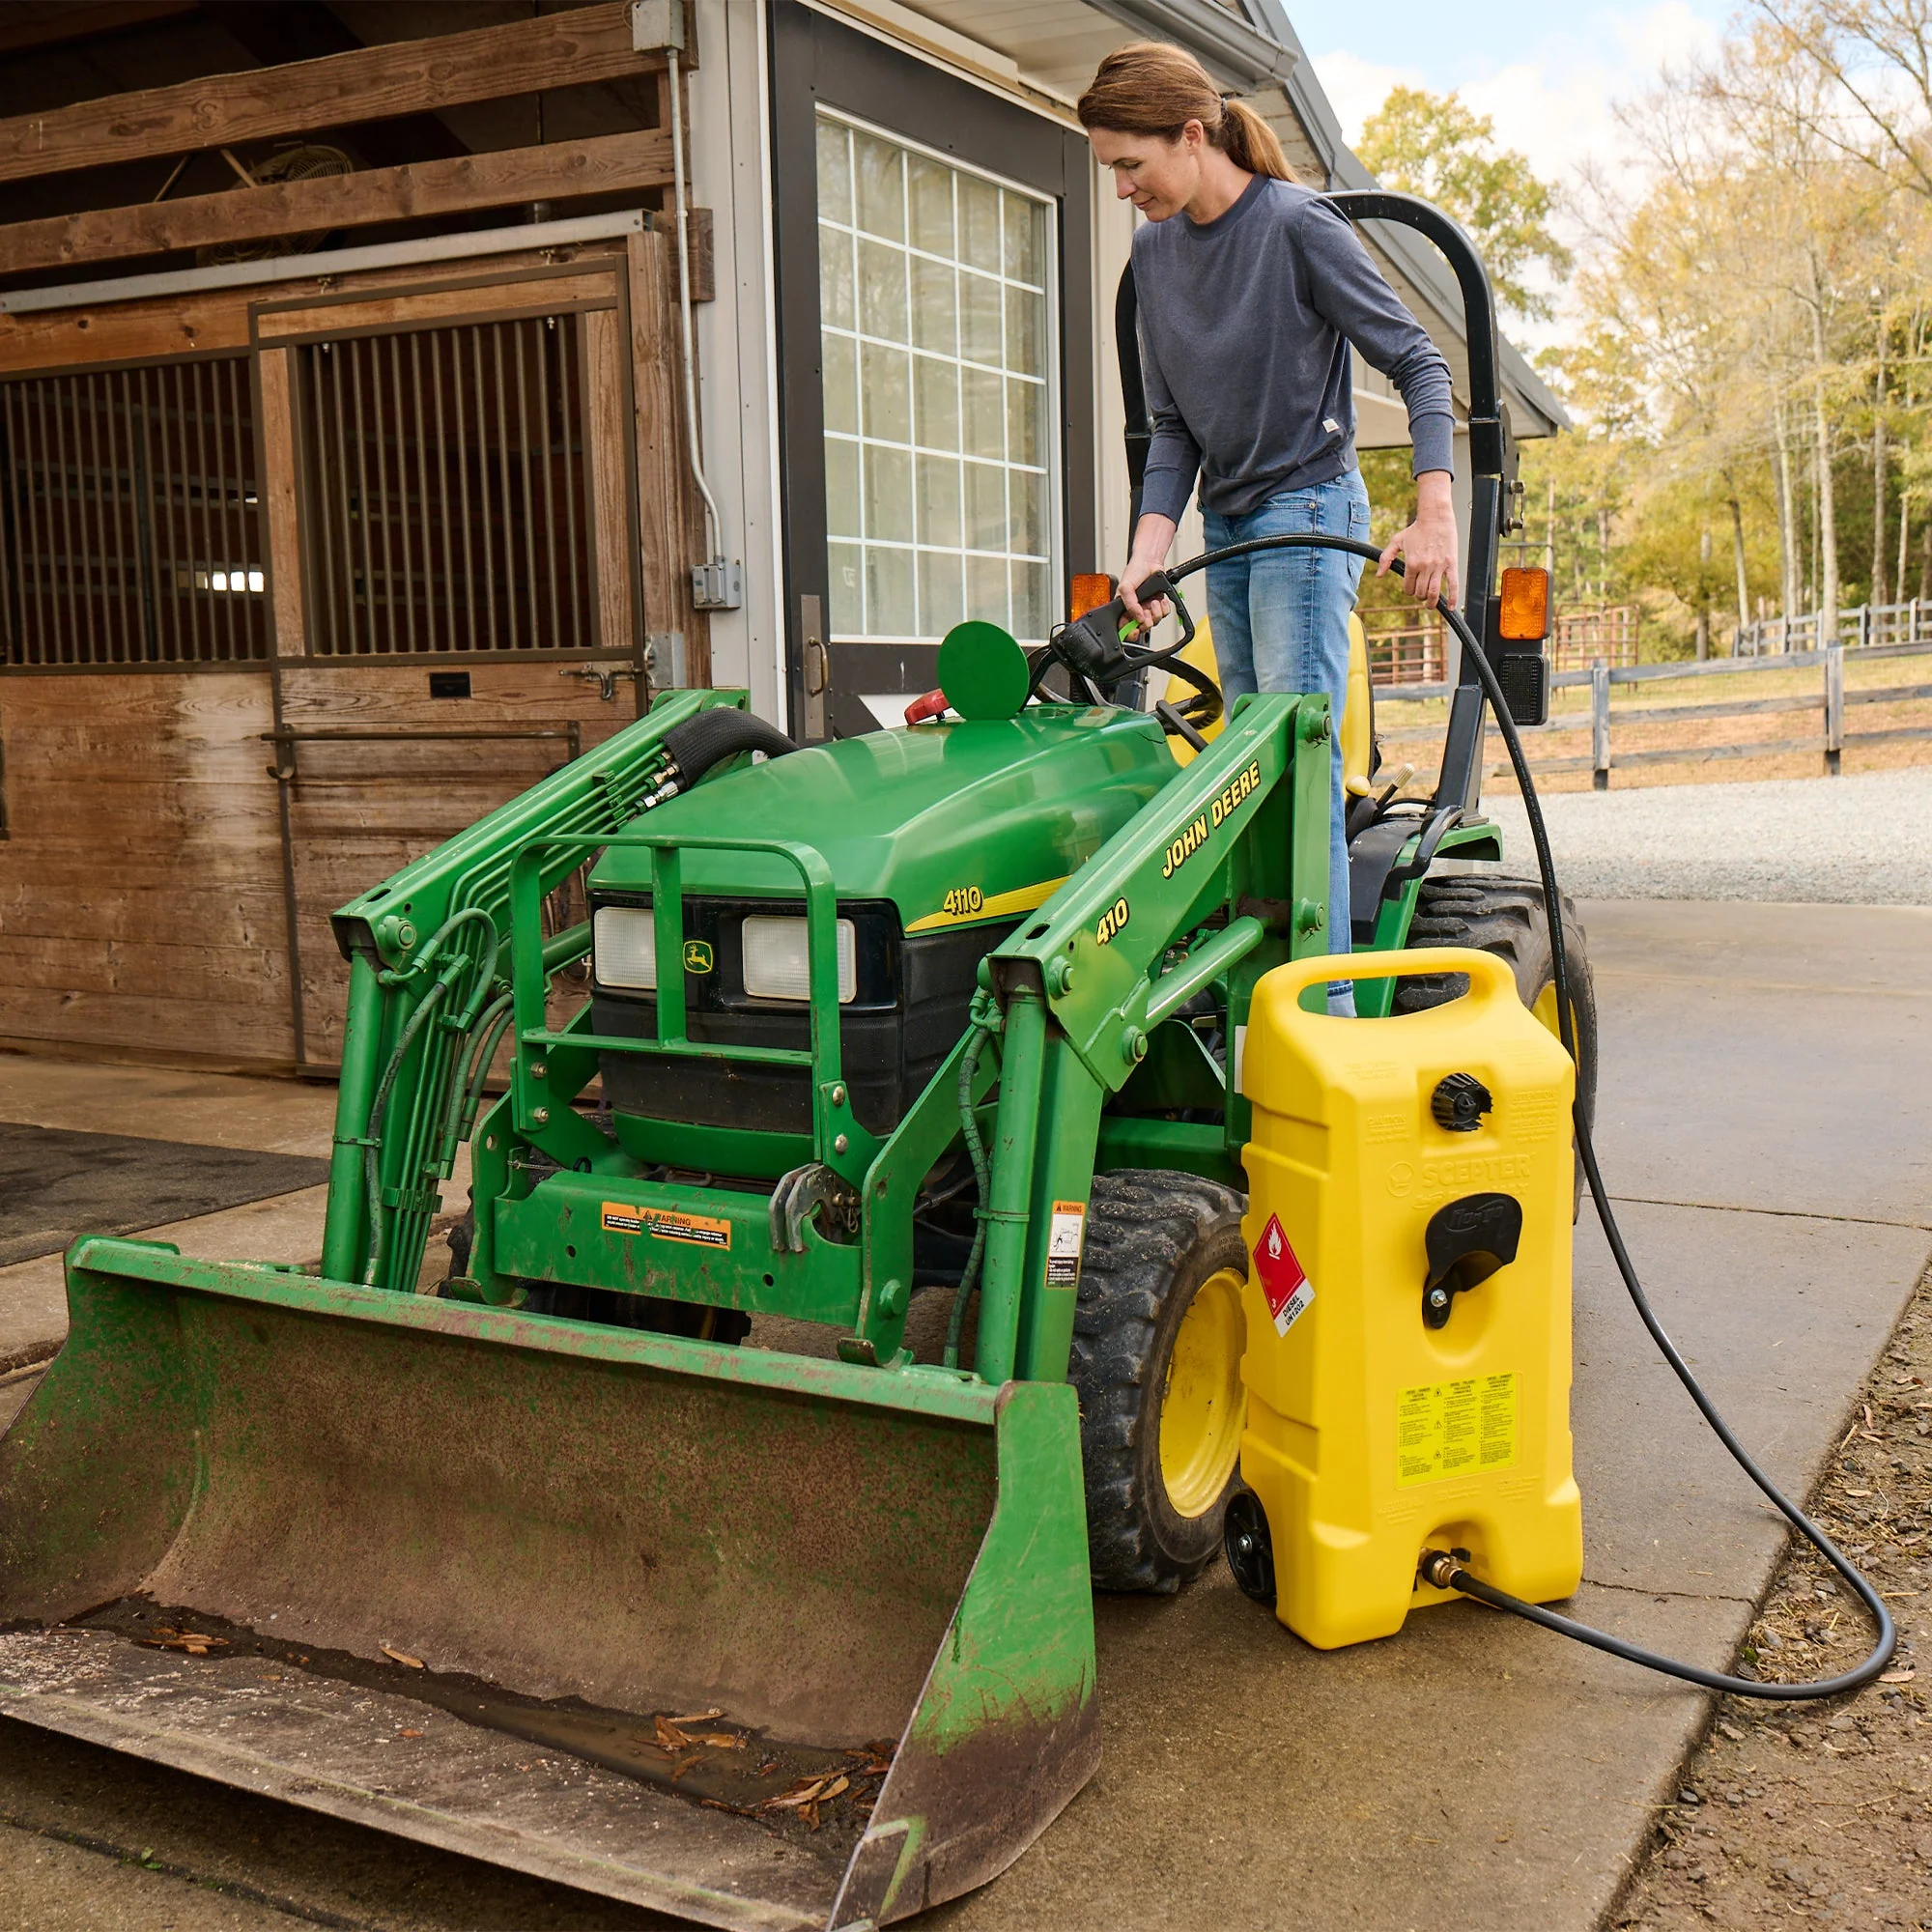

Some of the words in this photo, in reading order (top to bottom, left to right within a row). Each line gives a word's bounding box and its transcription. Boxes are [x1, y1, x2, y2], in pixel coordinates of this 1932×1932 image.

[1161, 812, 1208, 880] JOHN
[1210, 759, 1262, 829] DEERE
[943, 885, 983, 915] 4110
[1096, 897, 1129, 946] 410
[1422, 1154, 1531, 1189] SCEPTER
[653, 1212, 692, 1226] ARNING
[1283, 1294, 1299, 1317] DIESEL
[1285, 1299, 1304, 1325] UN1202
